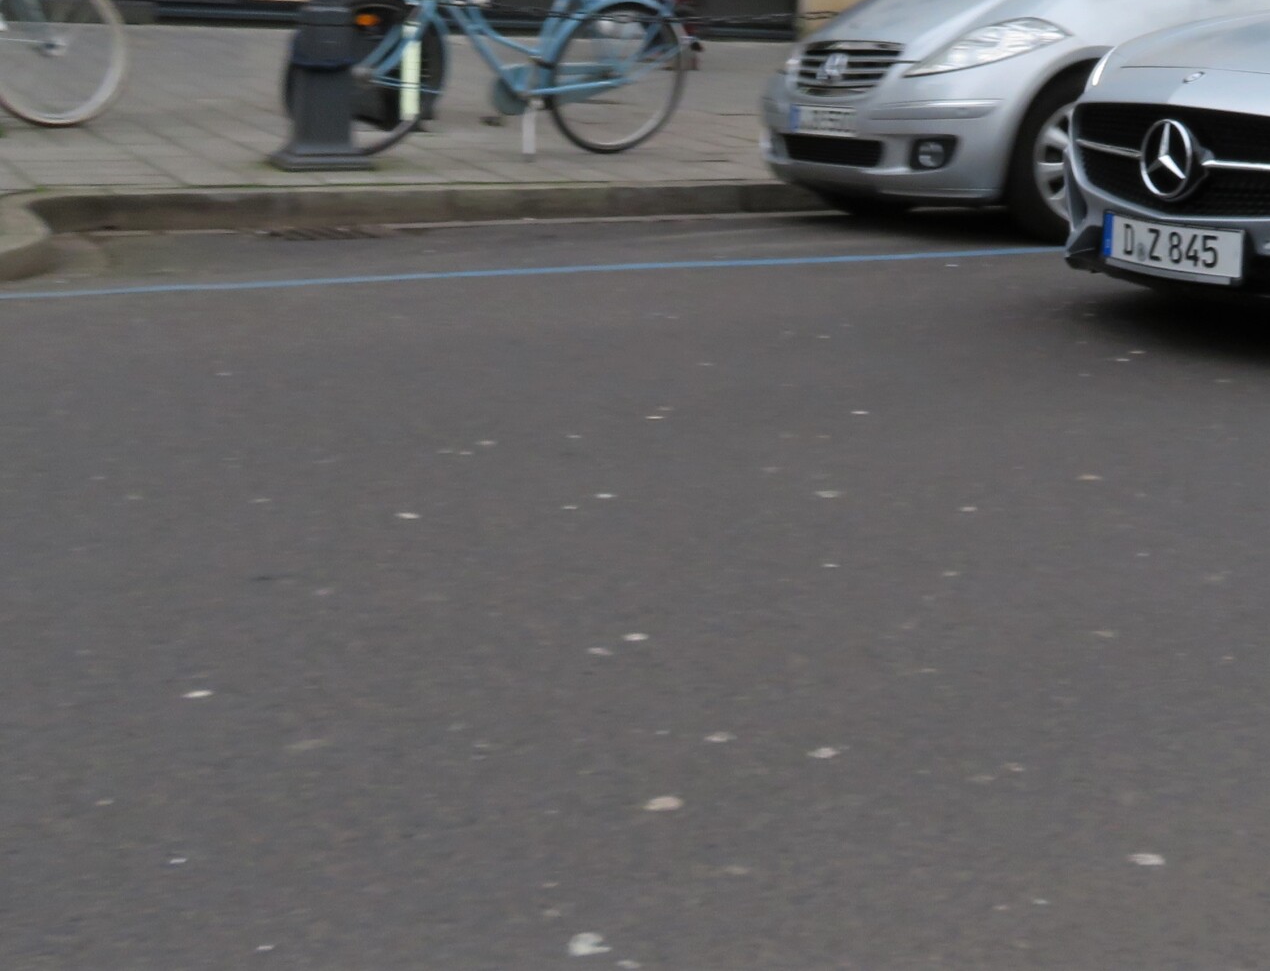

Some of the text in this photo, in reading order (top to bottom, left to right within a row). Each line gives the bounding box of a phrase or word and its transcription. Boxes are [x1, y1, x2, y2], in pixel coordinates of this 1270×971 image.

[1123, 223, 1218, 268] D Z 845
